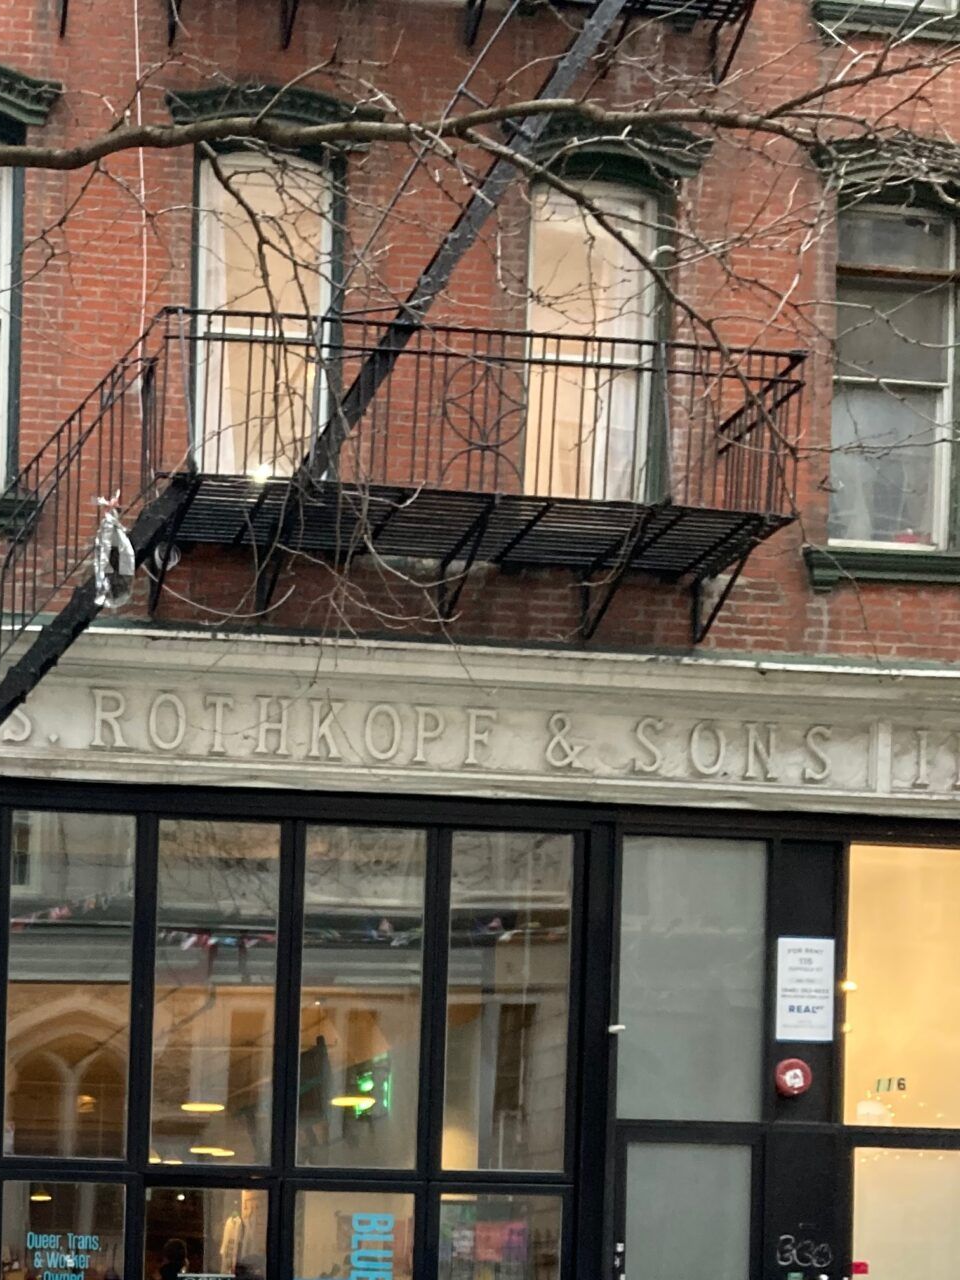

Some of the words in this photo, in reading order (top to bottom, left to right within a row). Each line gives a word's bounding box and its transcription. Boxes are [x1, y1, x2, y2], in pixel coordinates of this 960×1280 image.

[89, 686, 499, 767] ROTHKOPF
[545, 711, 589, 769] &
[634, 716, 835, 785] SONS
[876, 1077, 906, 1092] 116
[46, 1251, 90, 1269] Woker
